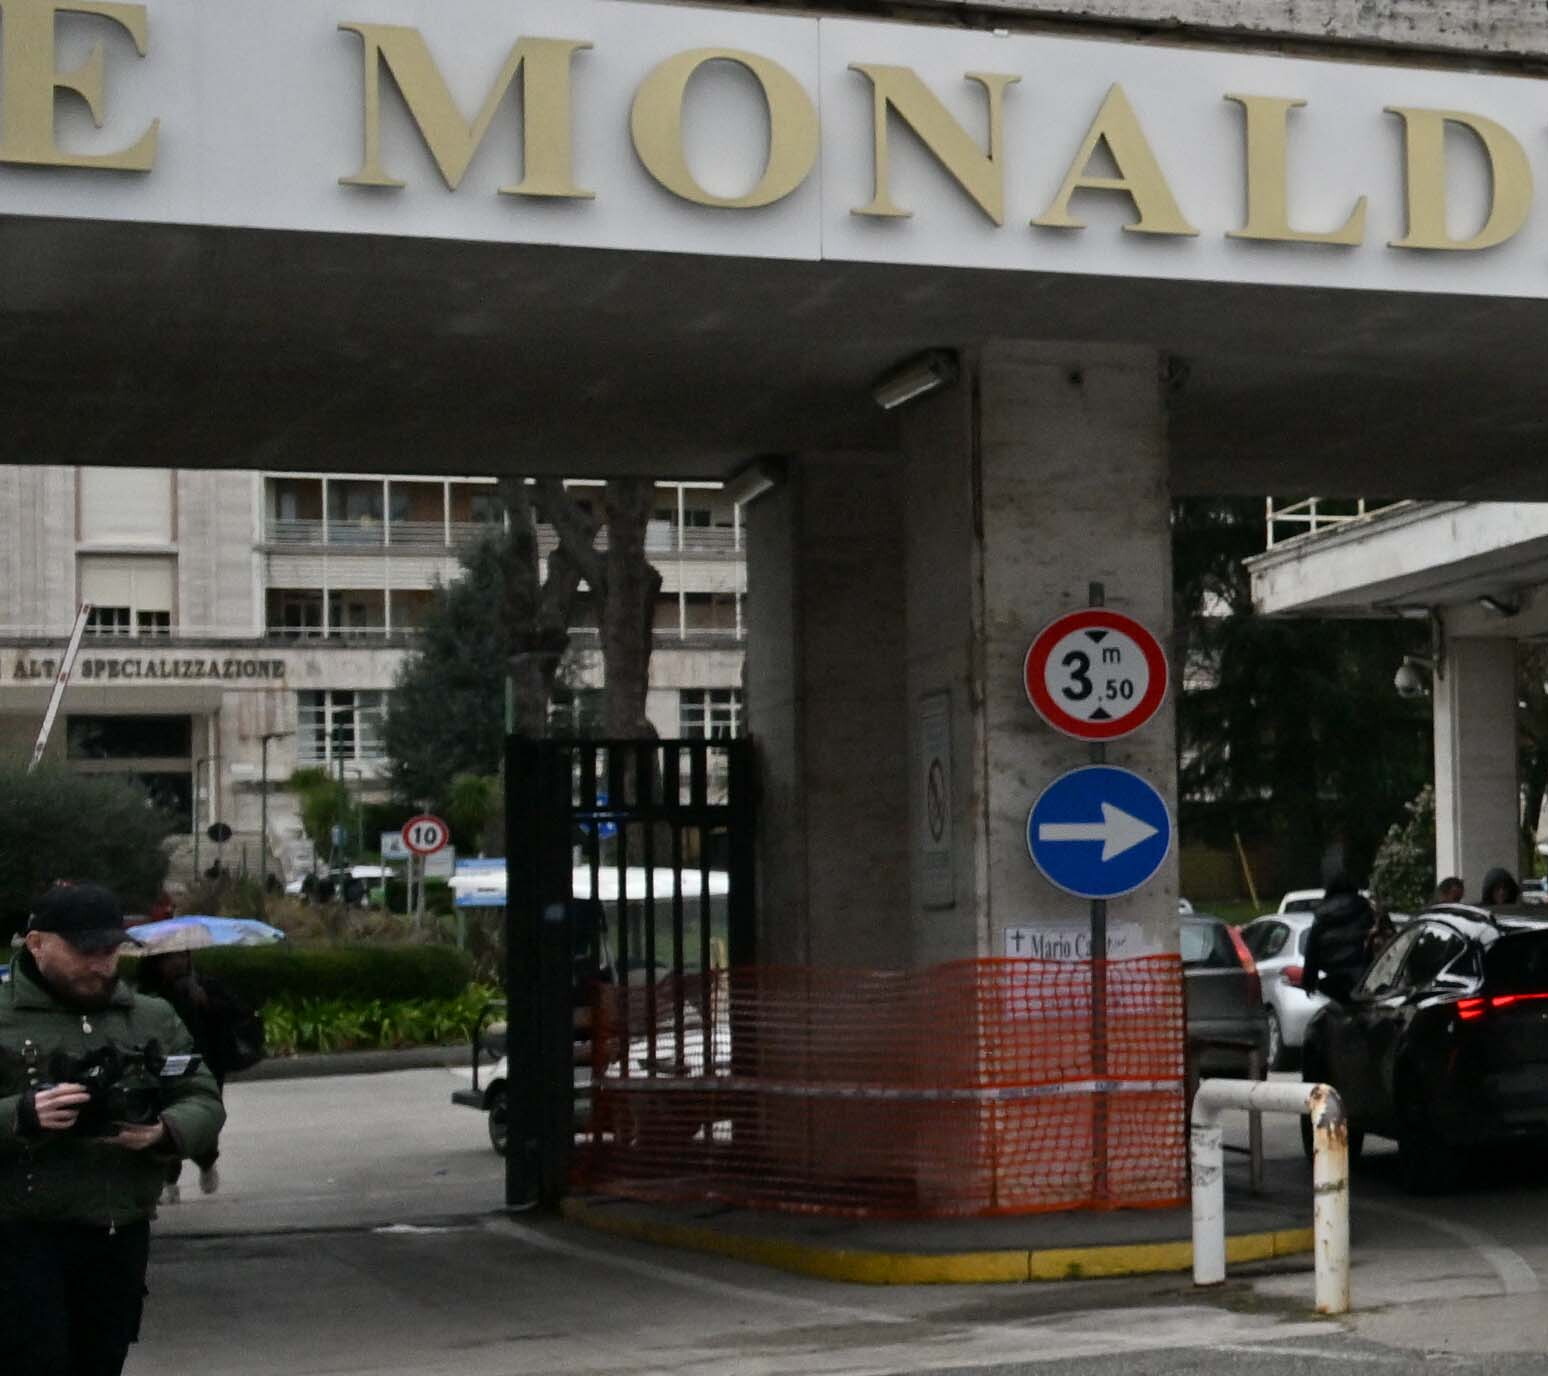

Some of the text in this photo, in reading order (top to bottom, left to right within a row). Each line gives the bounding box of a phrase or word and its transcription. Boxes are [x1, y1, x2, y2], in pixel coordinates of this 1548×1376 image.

[13, 658, 287, 680] ALT SPECIALIZZAZIONE
[413, 827, 437, 846] 10
